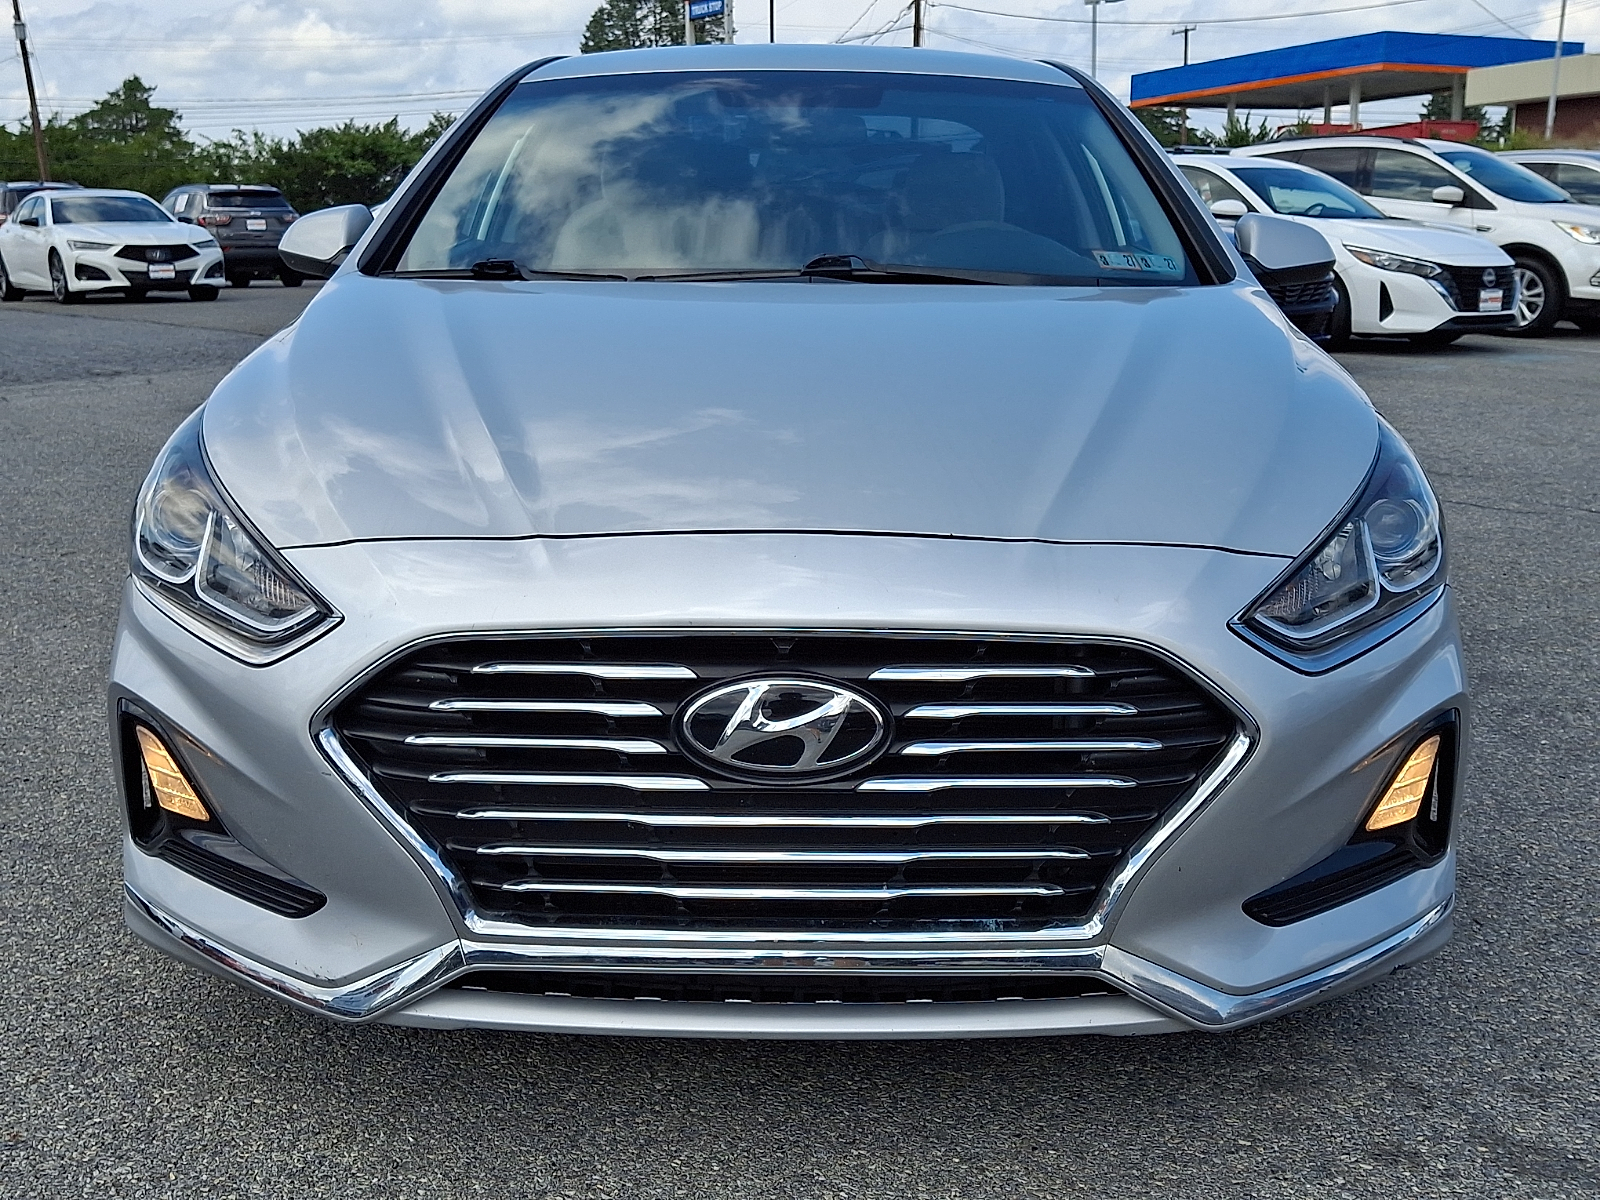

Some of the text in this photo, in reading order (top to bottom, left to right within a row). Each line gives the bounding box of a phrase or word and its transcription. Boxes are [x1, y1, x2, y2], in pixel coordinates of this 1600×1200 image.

[691, 1, 722, 15] TRUCK STOP
[1100, 254, 1136, 267] 3 27
[1163, 258, 1176, 270] 27
